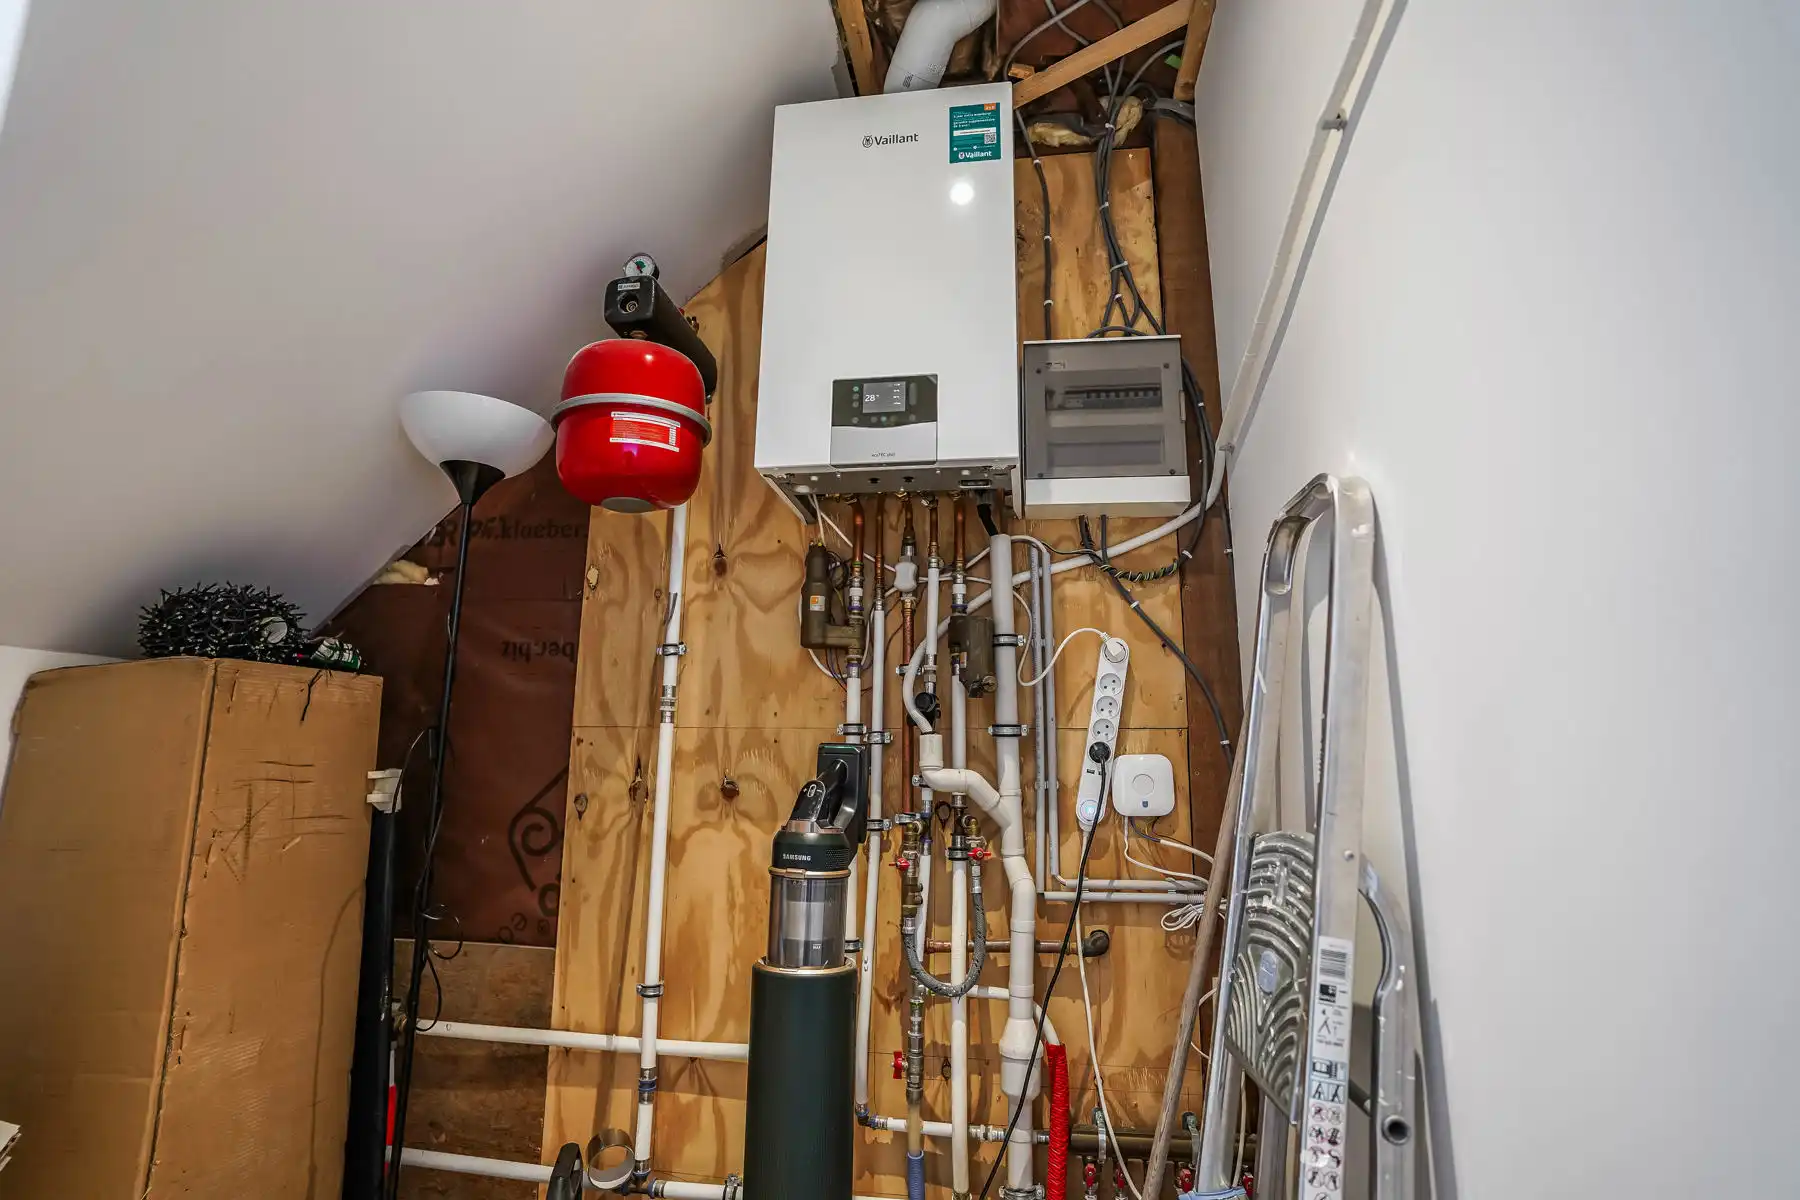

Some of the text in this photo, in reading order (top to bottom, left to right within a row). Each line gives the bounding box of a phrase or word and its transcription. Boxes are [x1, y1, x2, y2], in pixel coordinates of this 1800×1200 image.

[874, 133, 919, 146] Vaillant
[965, 150, 992, 159] Vaillant
[782, 853, 812, 861] SAMSUNG
